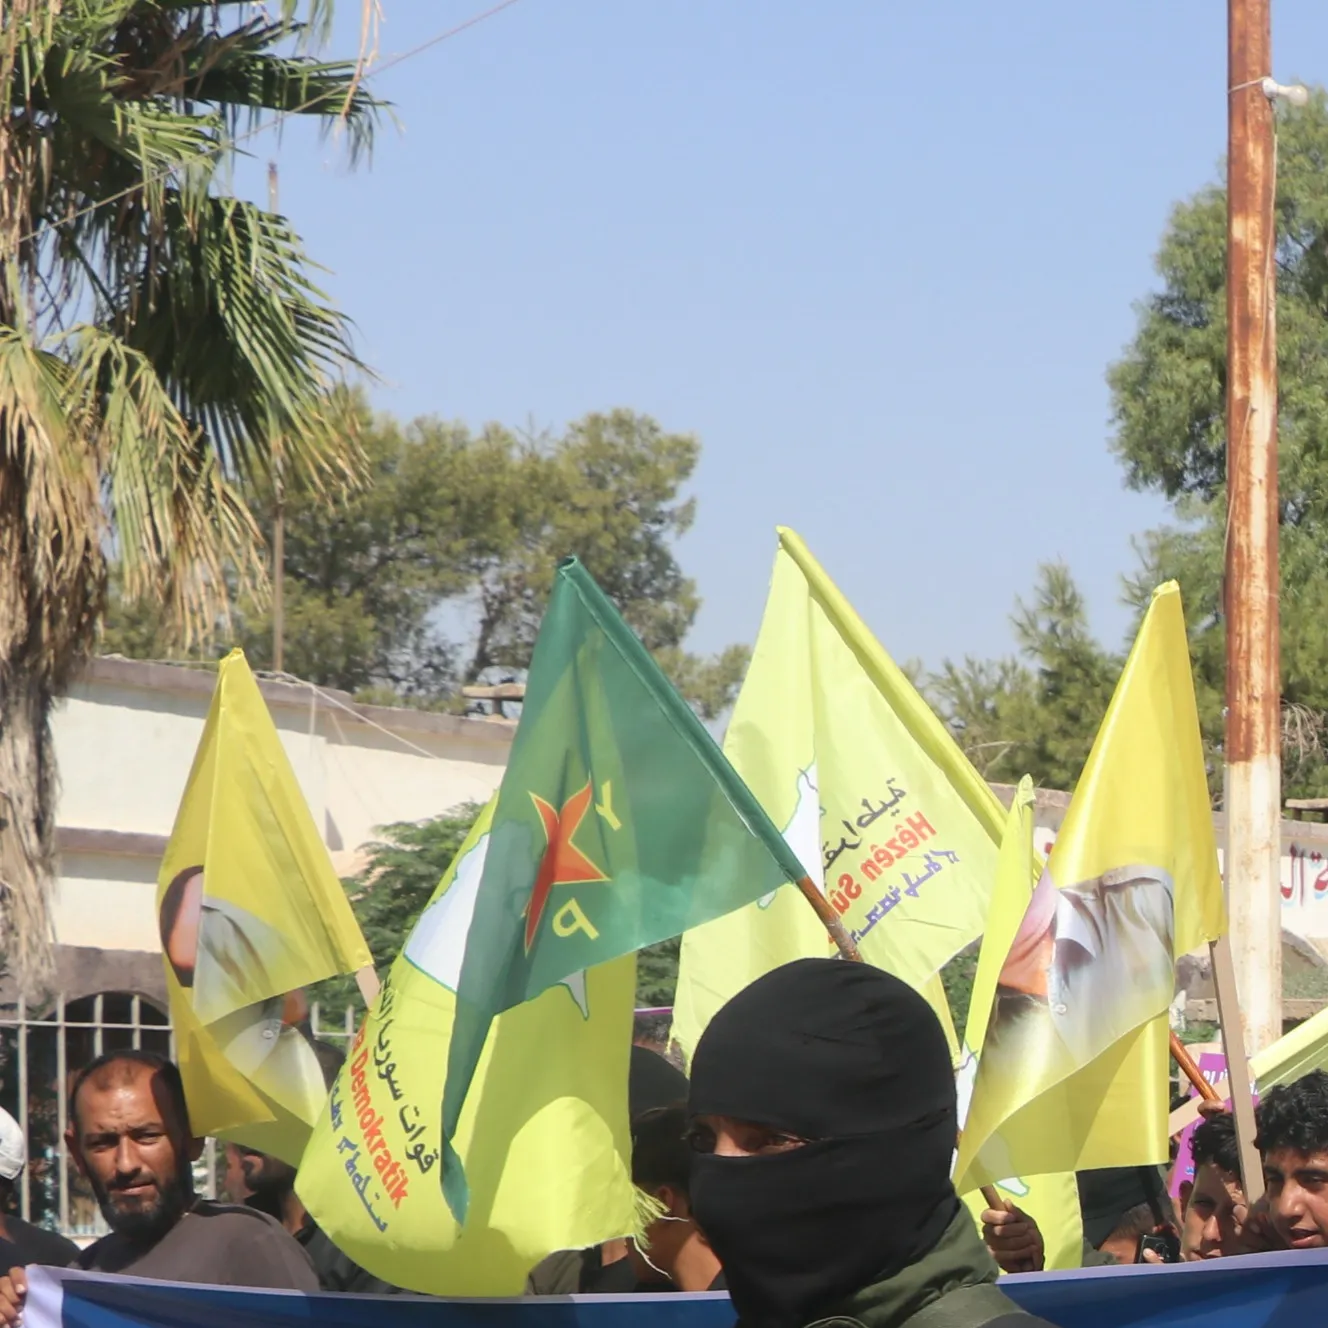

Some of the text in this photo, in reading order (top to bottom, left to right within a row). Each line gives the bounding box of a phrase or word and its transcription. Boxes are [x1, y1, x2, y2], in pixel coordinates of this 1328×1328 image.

[374, 1018, 403, 1101] سوريا
[350, 1047, 409, 1210] Demokratîk
[399, 1104, 439, 1174] قوات
